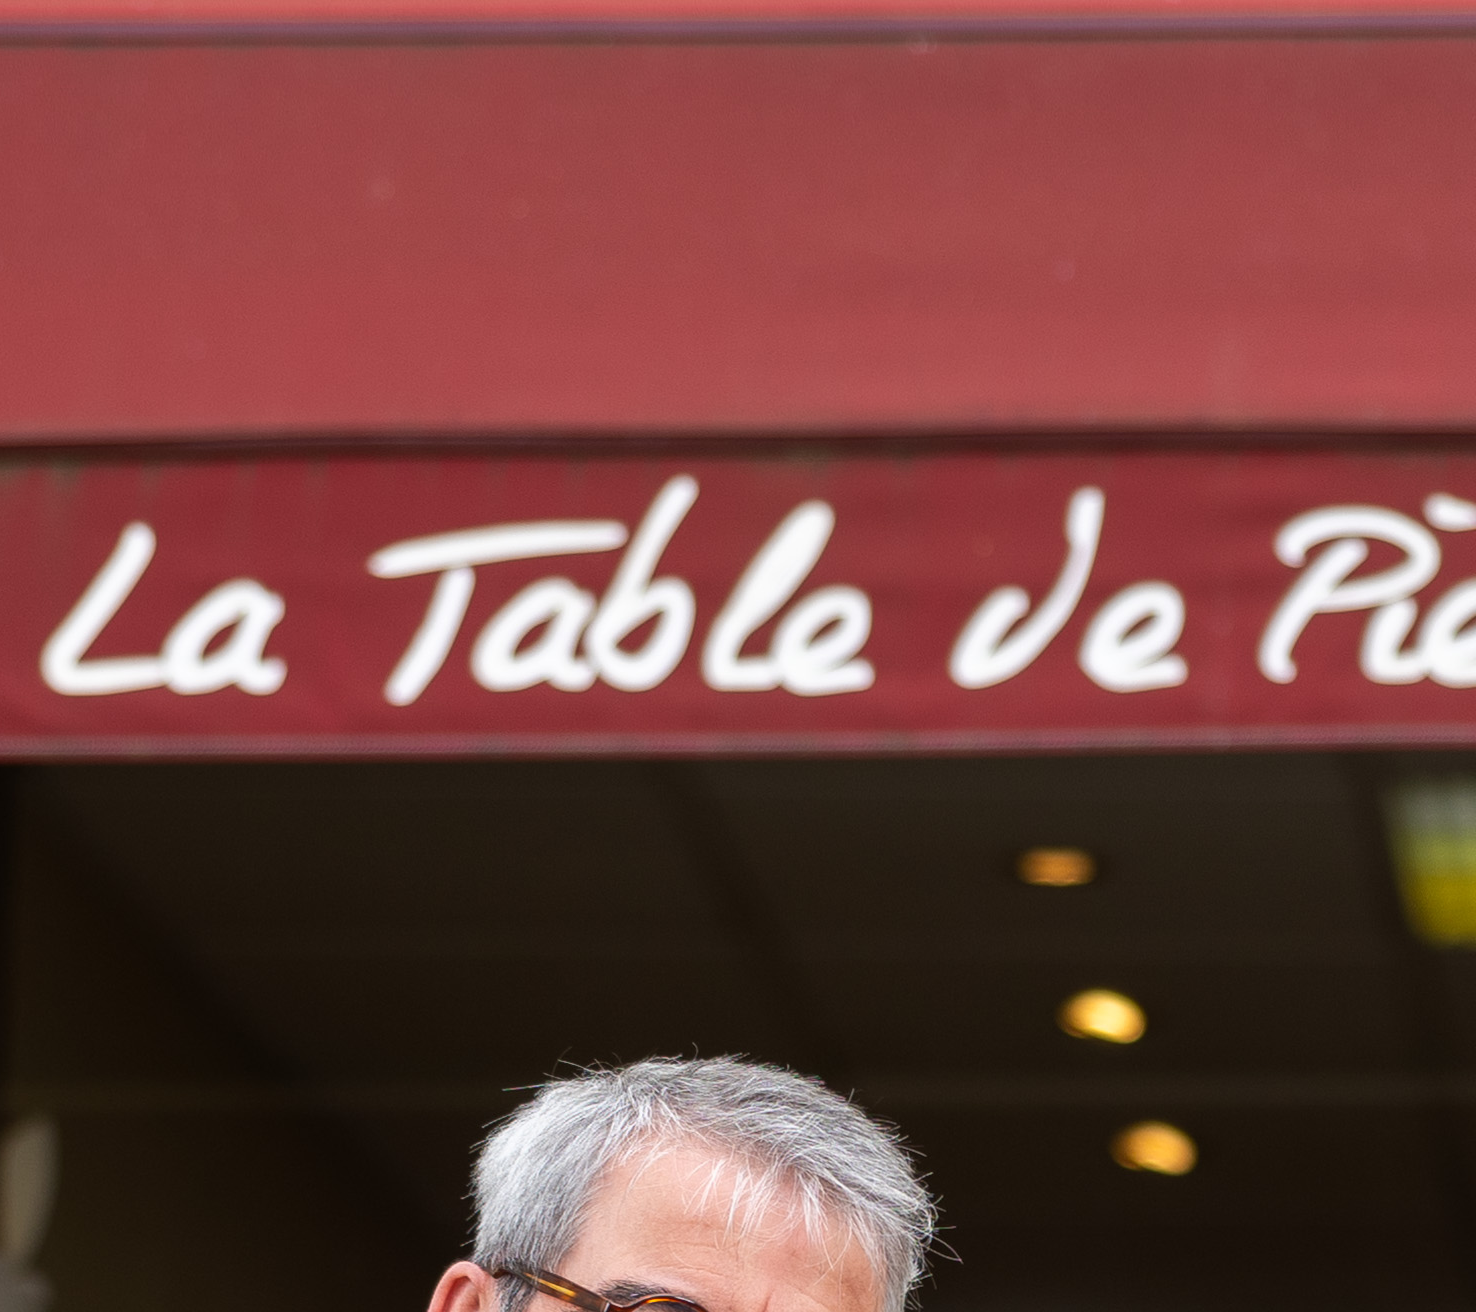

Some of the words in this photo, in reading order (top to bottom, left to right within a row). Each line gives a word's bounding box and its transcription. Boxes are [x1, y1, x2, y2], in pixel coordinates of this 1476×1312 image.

[34, 516, 292, 702] La
[362, 469, 881, 711] Table
[941, 481, 1194, 698] de
